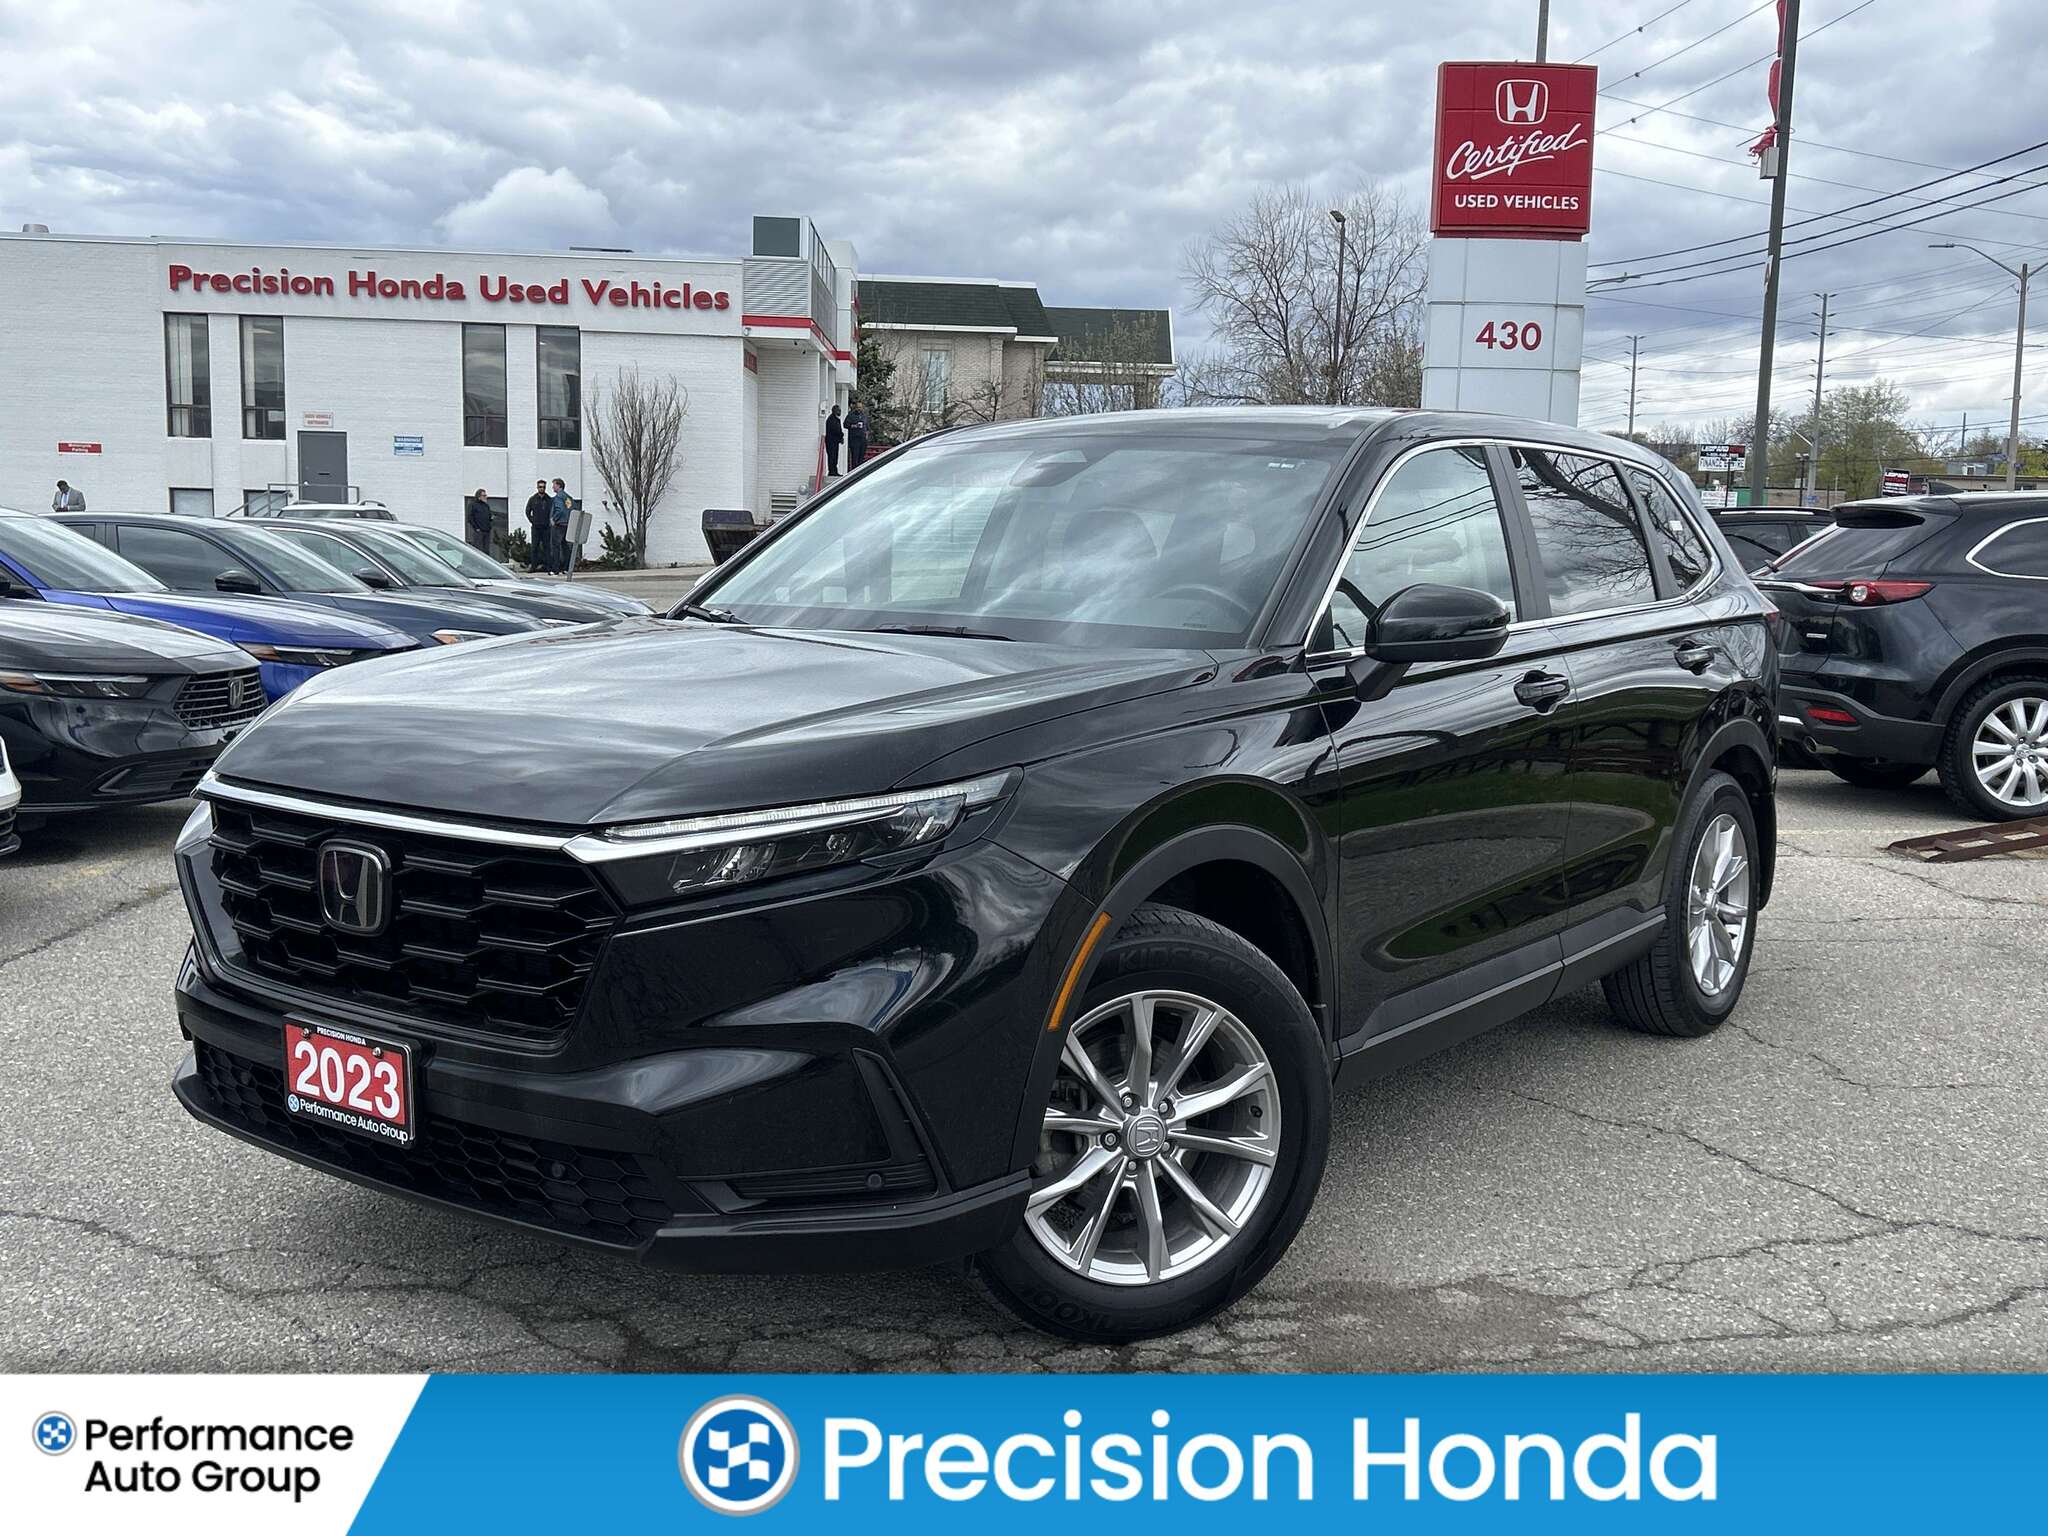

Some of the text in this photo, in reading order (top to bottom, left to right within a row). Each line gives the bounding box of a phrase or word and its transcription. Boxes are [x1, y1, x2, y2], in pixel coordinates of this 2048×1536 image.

[1446, 123, 1588, 180] Certified
[1455, 194, 1579, 210] USED VEHICLES
[168, 264, 731, 311] Precision Honda Used Vehicles
[1475, 320, 1542, 351] 430
[316, 1026, 367, 1046] PRECISION HONDA
[294, 1040, 401, 1119] 2023
[300, 1099, 408, 1144] Performance Auto Group
